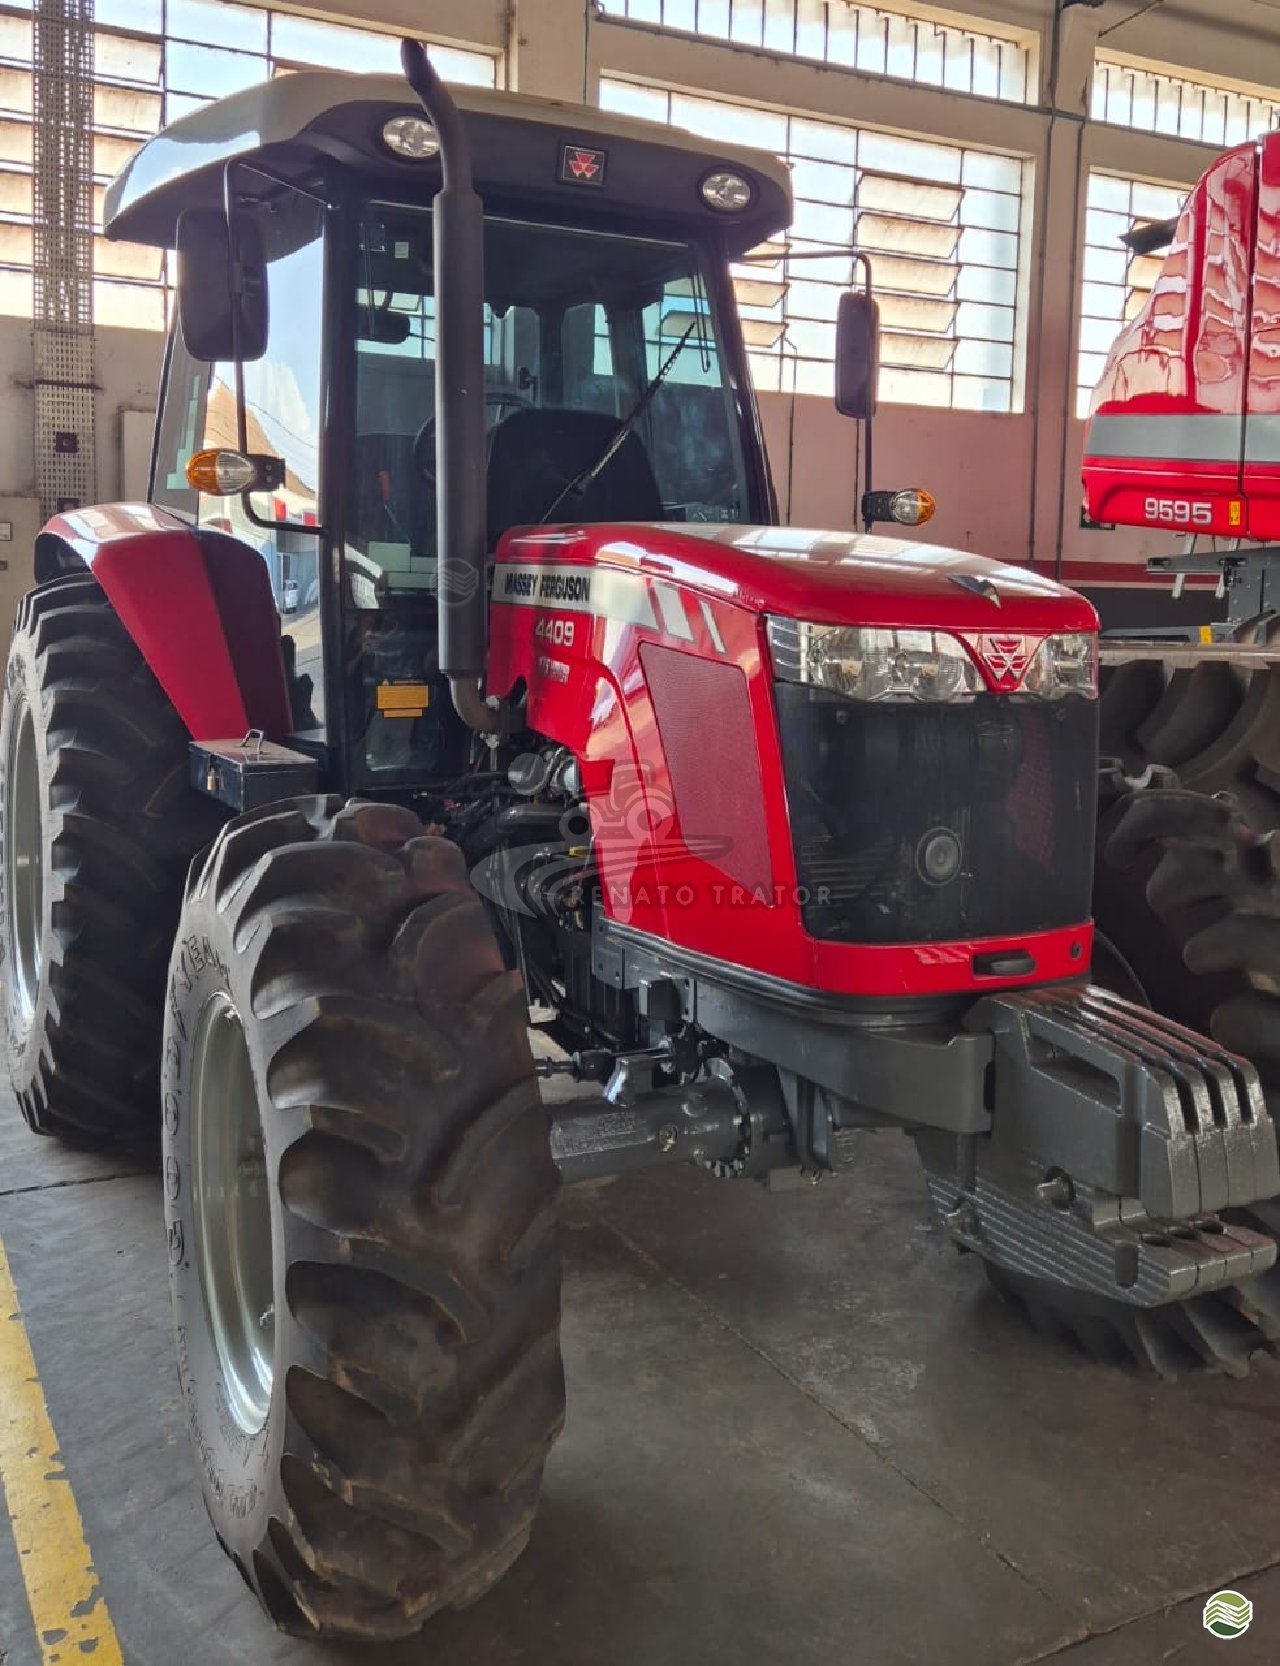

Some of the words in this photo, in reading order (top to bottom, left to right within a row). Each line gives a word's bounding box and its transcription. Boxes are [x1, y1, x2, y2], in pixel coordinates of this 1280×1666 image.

[1144, 497, 1213, 526] 9595
[504, 572, 539, 597] MASSEY
[540, 574, 592, 603] FERGUSON
[535, 618, 575, 647] 4409
